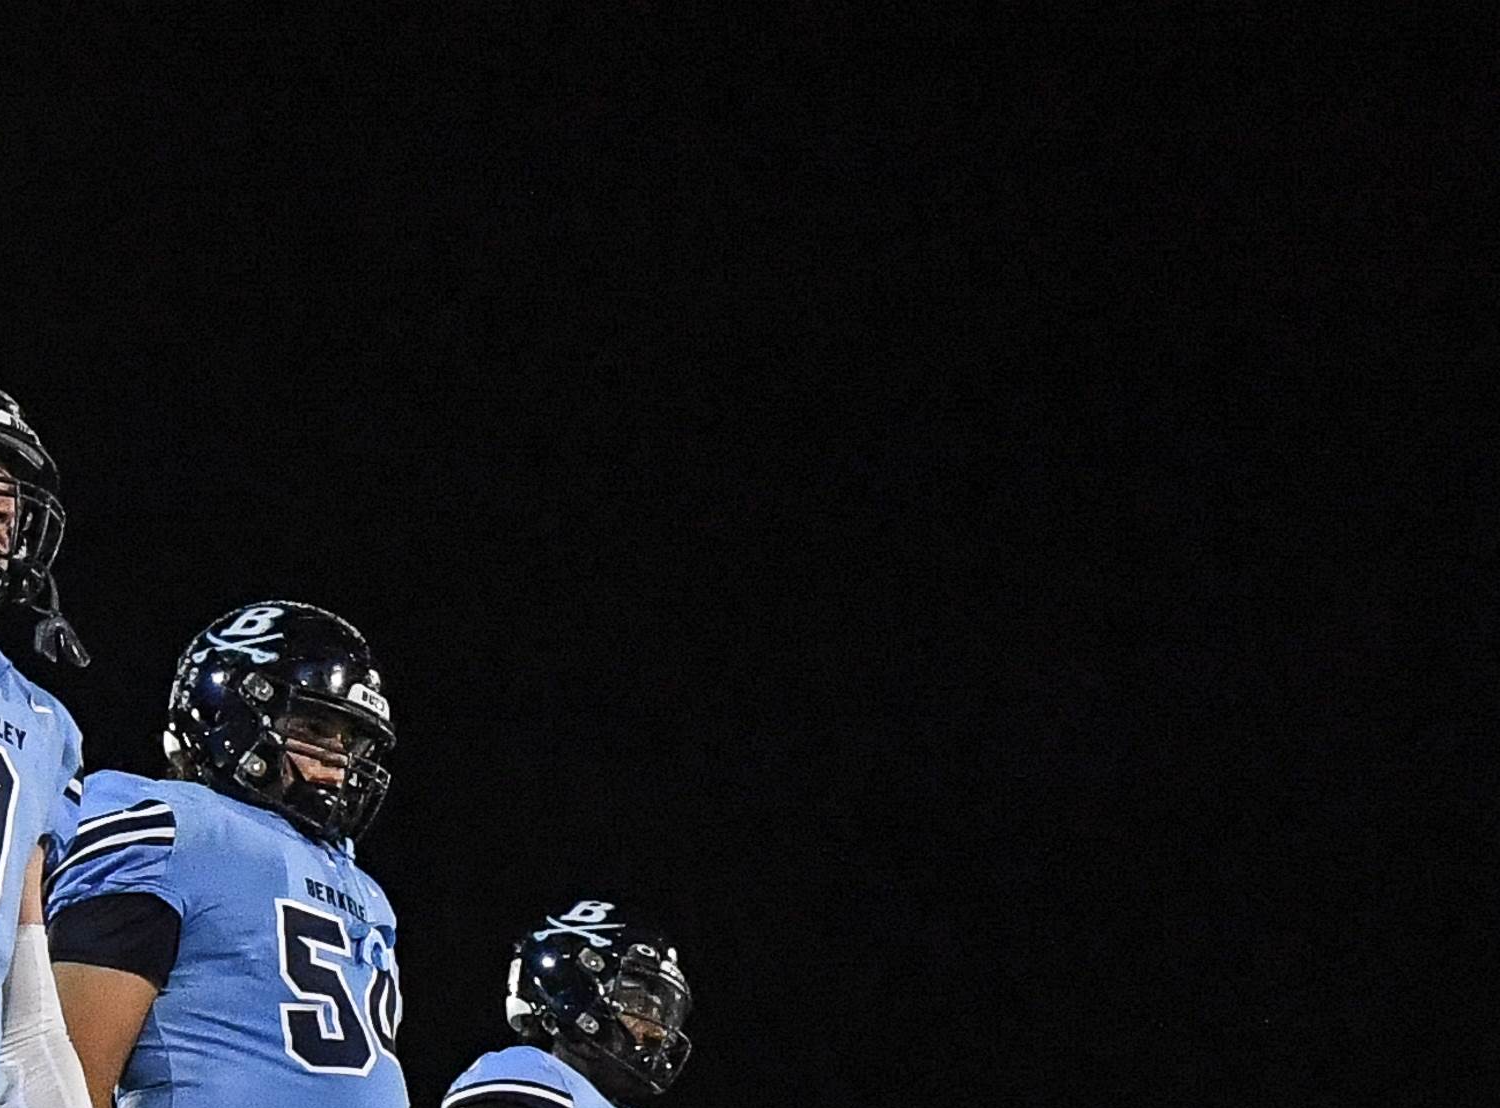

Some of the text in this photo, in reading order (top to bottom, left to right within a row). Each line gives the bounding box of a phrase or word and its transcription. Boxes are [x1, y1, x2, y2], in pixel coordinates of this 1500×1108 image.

[219, 606, 285, 637] B
[304, 877, 366, 922] BERKELE
[559, 900, 616, 923] B
[274, 897, 403, 1077] 50
